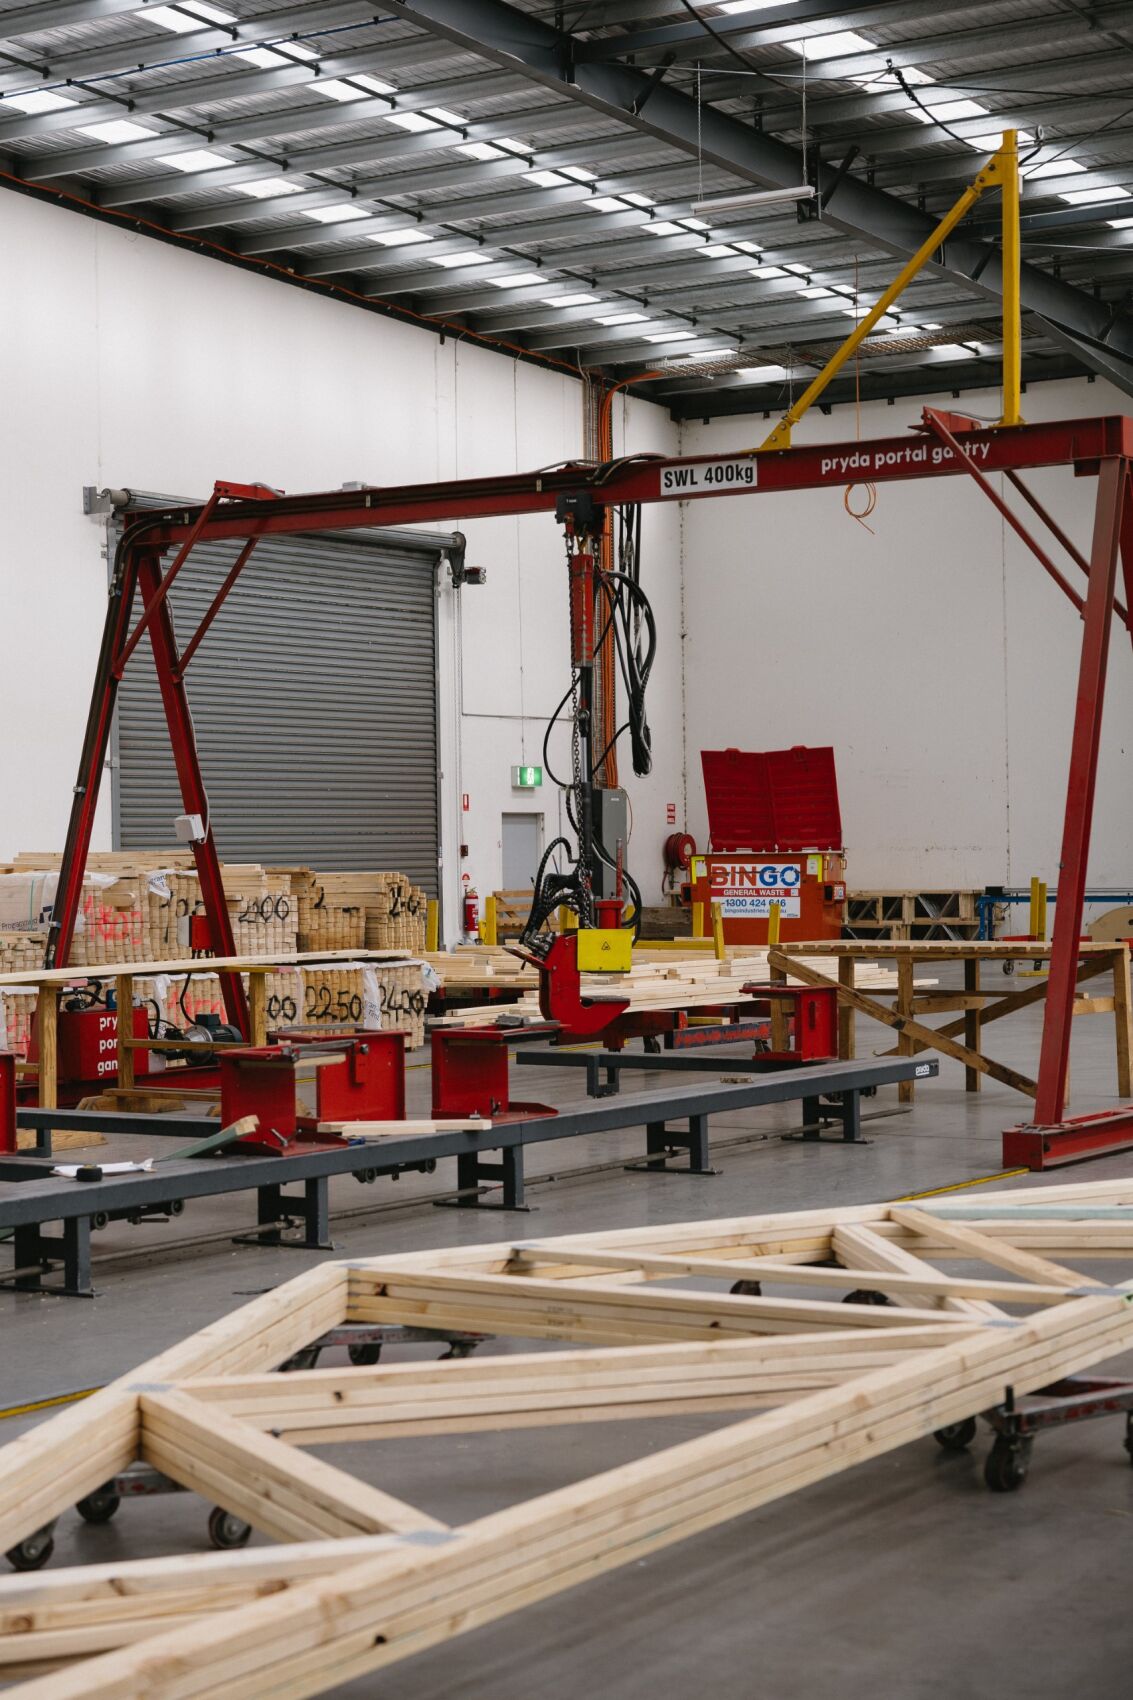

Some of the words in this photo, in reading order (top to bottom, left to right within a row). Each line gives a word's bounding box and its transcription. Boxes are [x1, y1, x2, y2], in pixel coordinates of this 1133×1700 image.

[821, 451, 870, 475] pryda
[875, 444, 927, 469] portal
[932, 440, 990, 464] gatry
[664, 469, 698, 488] SWL
[704, 464, 753, 484] 400kg
[711, 866, 799, 886] BINGO
[725, 899, 747, 907] 1300
[749, 899, 766, 907] 424
[306, 986, 362, 1022] 2250
